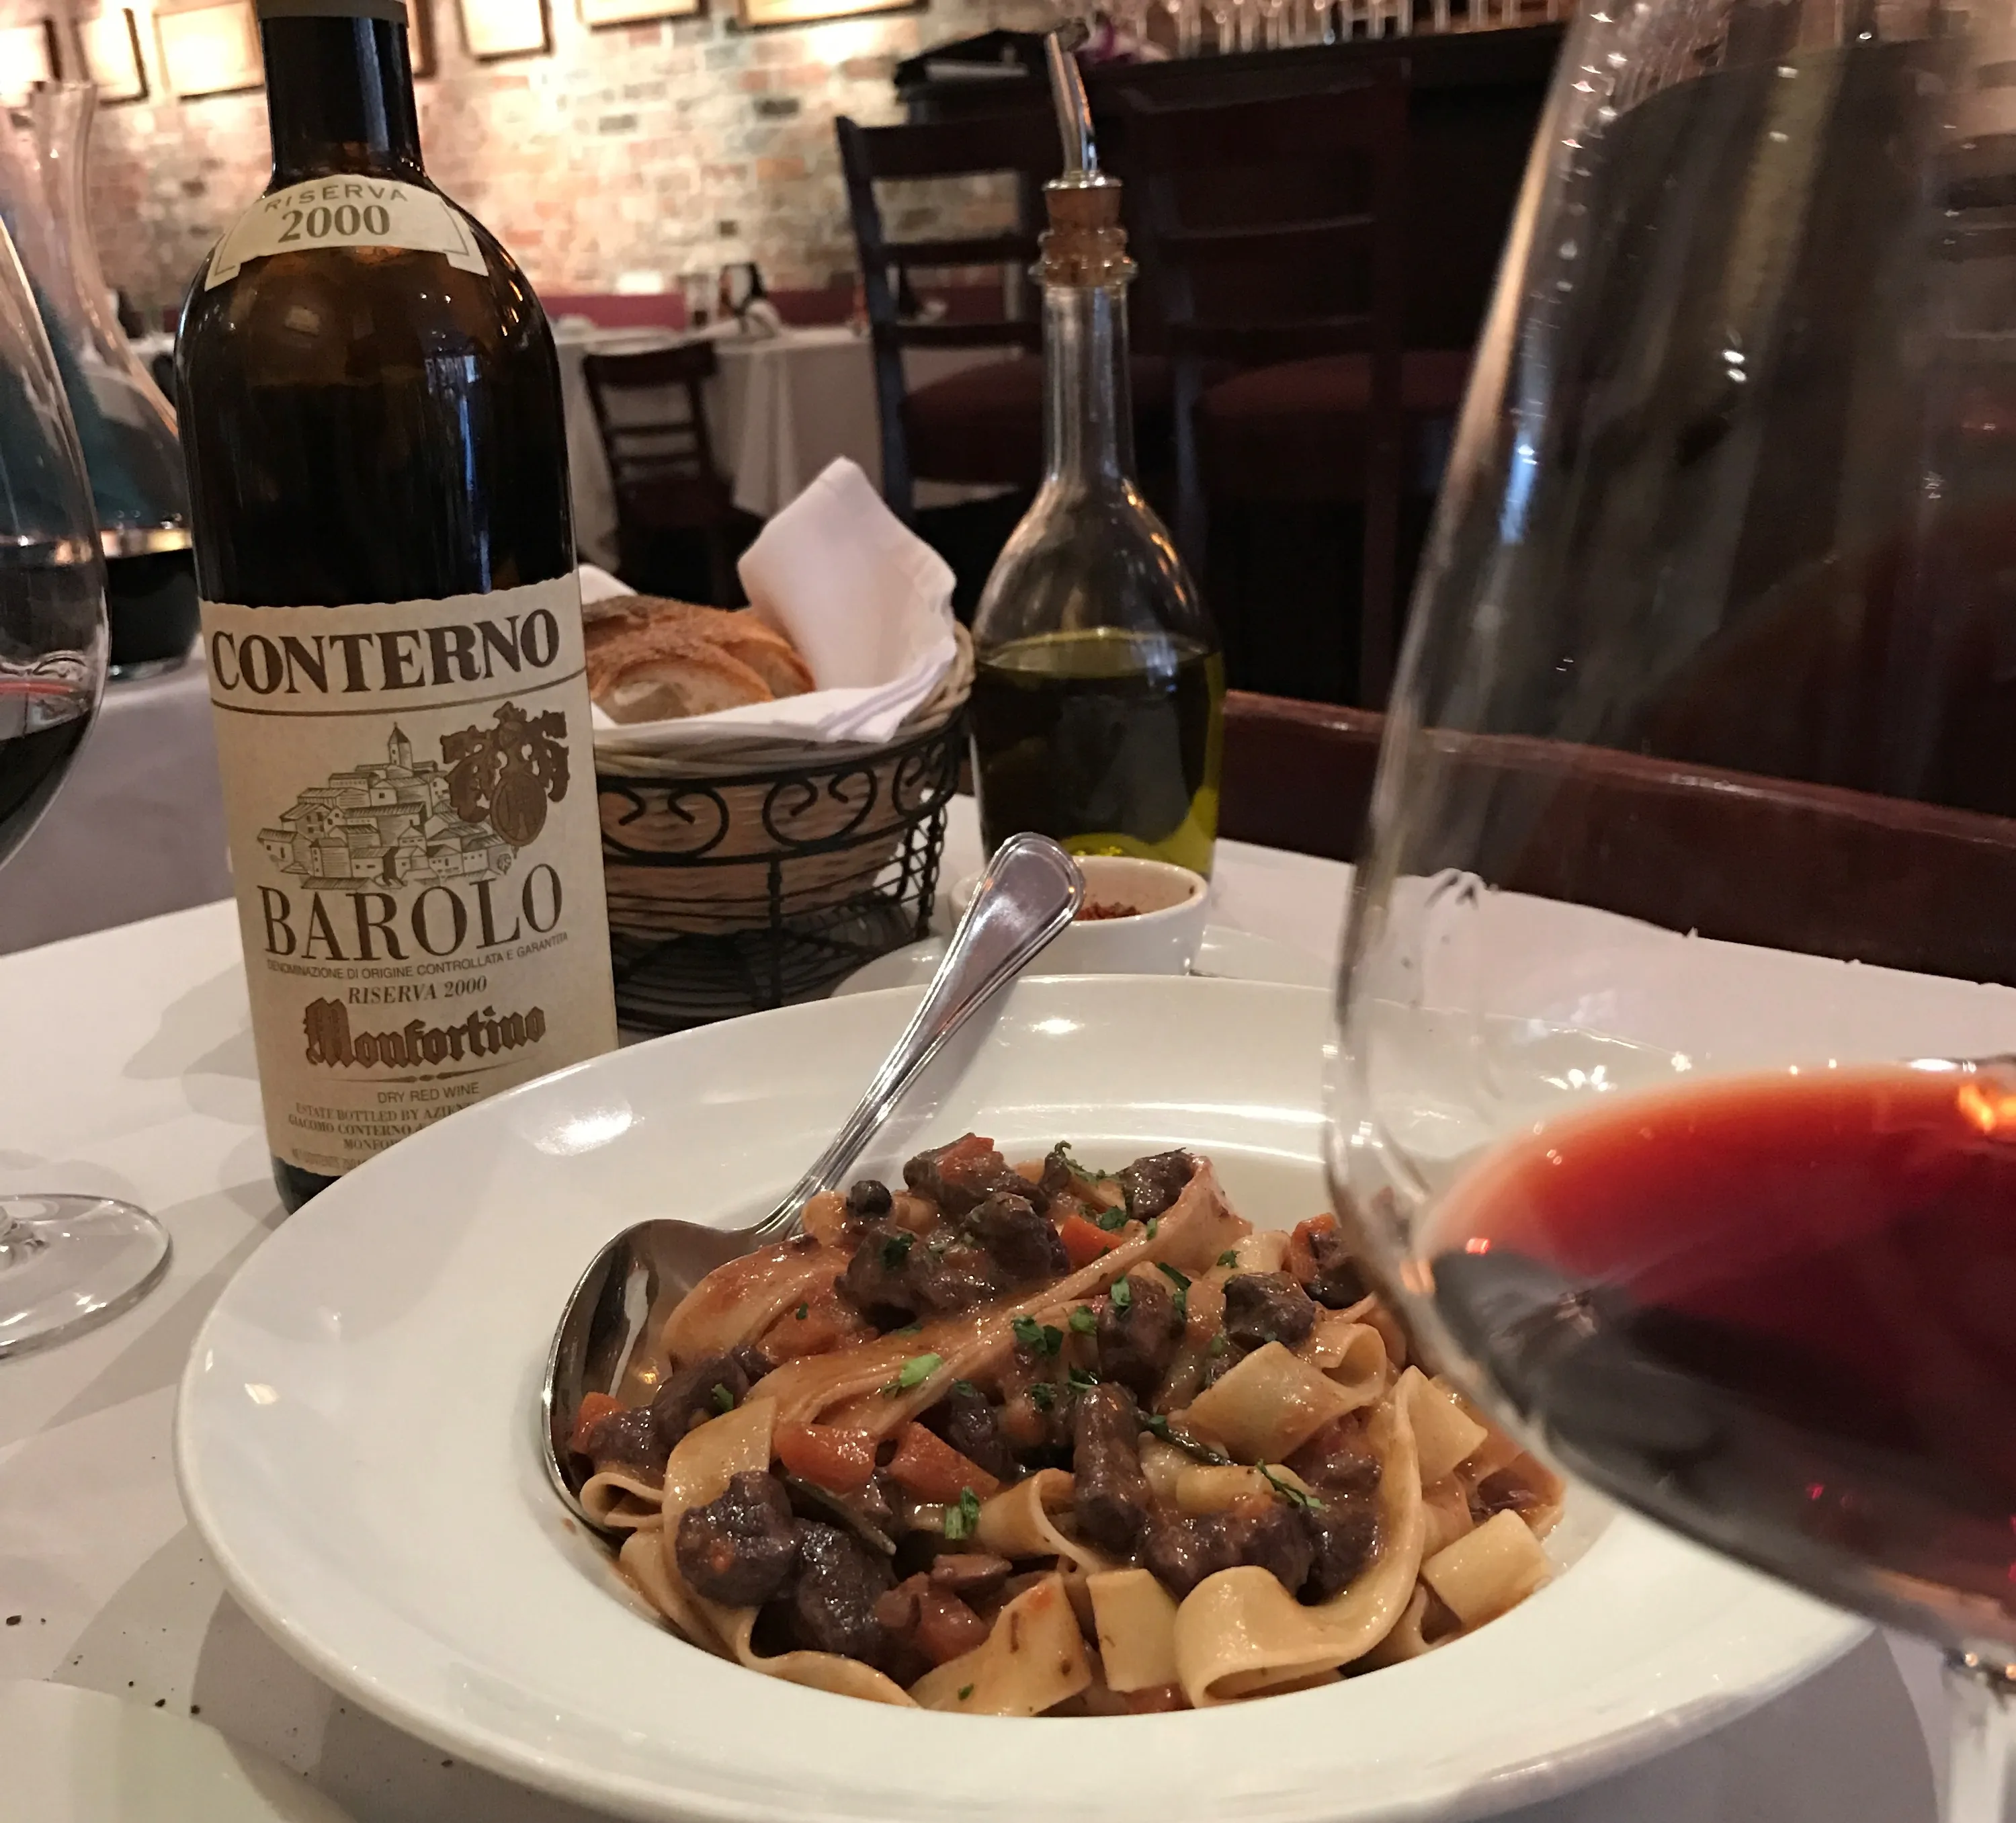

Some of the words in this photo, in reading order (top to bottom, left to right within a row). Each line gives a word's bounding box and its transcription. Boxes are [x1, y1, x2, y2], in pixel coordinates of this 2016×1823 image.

[264, 184, 408, 212] RISERVA
[278, 205, 390, 243] 2000
[212, 609, 559, 694] CONTERNO
[257, 863, 562, 961] BAROLO
[266, 959, 343, 979] DENOMINAZIONE
[347, 968, 359, 979] DI
[362, 966, 413, 979] ORIGINE
[417, 953, 503, 975] CONTROLLATA
[506, 950, 513, 960] E
[517, 931, 568, 958] GARANTITA
[348, 981, 437, 1004] RISERVA
[444, 976, 487, 998] 2000
[303, 997, 546, 1068] Monfortino
[378, 1091, 405, 1103] DRY
[410, 1089, 439, 1102] RED
[442, 1082, 479, 1098] WINE
[288, 1113, 335, 1133] GIACOMO
[337, 1124, 411, 1136] CONTERNO
[296, 1102, 334, 1119] ESTATE
[336, 1109, 396, 1122] BOTTLED
[401, 1109, 419, 1121] BY
